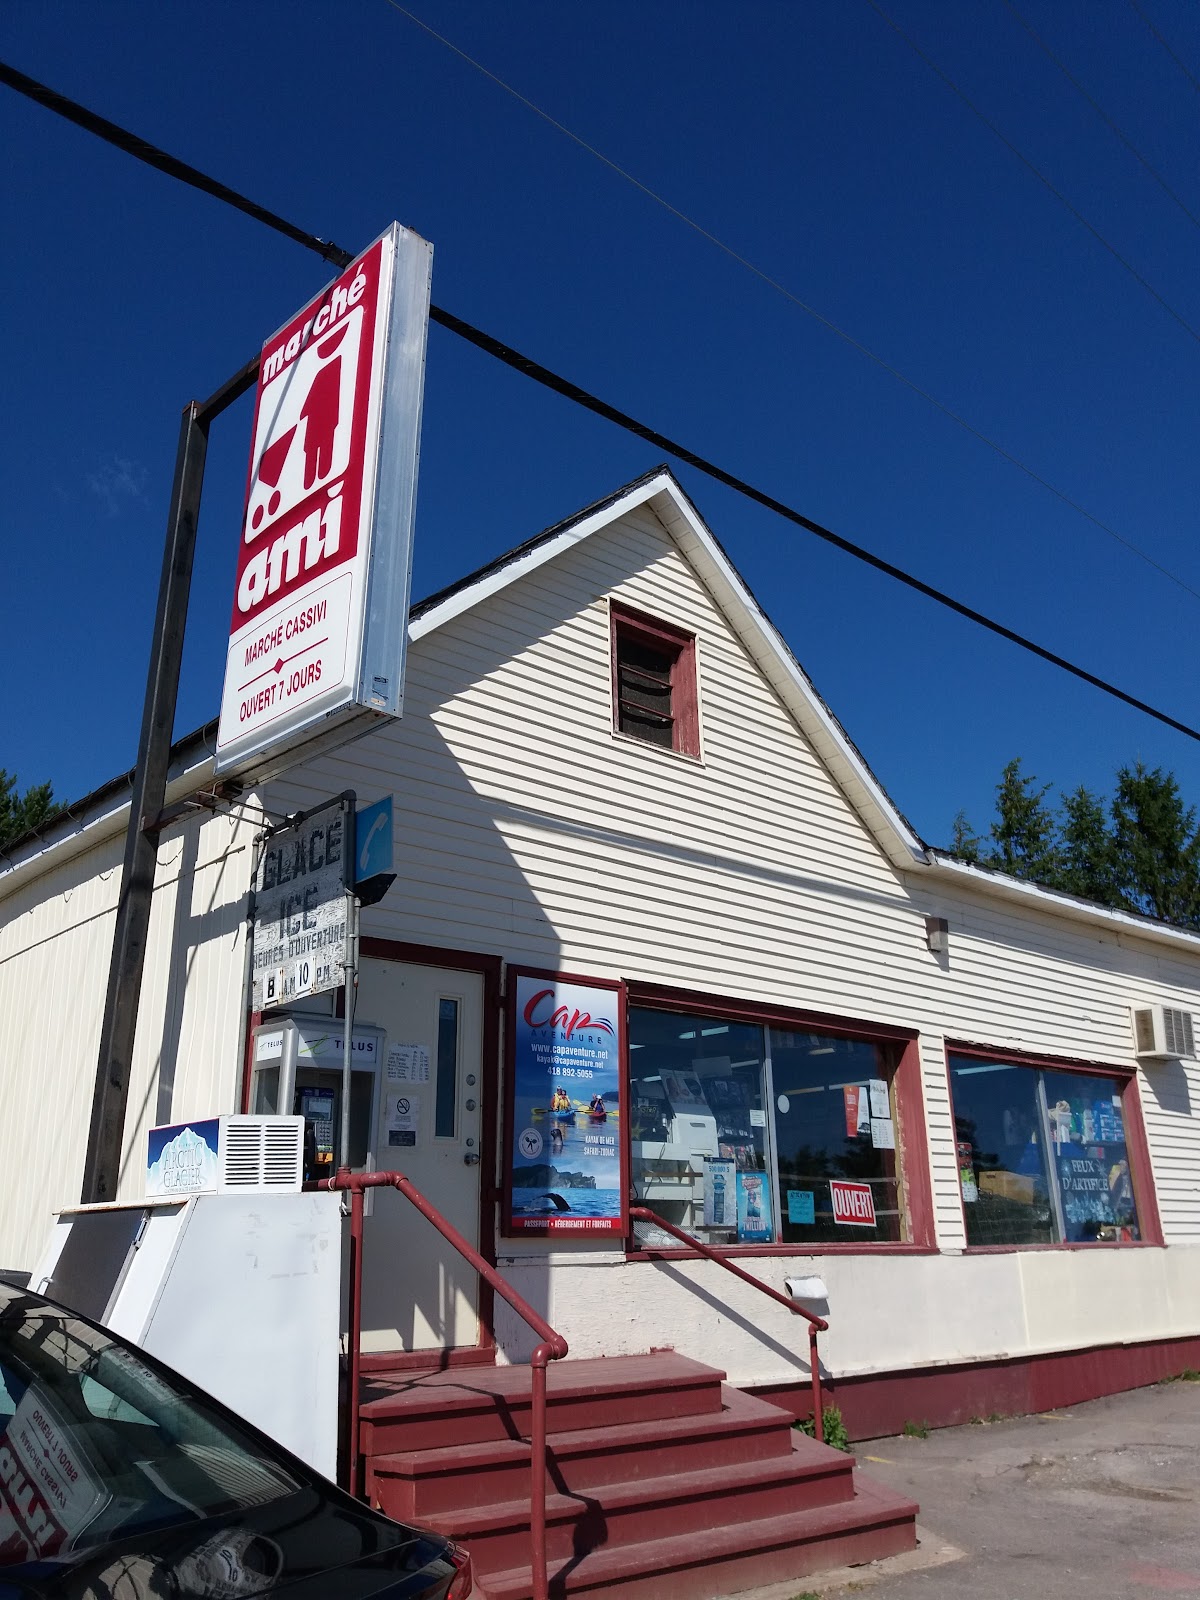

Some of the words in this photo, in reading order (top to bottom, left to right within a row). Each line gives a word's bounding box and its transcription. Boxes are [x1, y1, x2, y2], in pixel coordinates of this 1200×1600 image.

[262, 262, 366, 385] marché
[237, 480, 344, 612] ami
[244, 620, 283, 667] MARCHÉ
[285, 600, 327, 640] CASSIVI
[239, 683, 277, 722] OUVERT
[279, 681, 285, 701] 7
[286, 659, 322, 697] JOURS
[262, 820, 342, 891] GLACE
[280, 885, 317, 939] ICE
[299, 962, 309, 986] 10
[523, 989, 614, 1041] Cap
[267, 1039, 283, 1048] TELUS
[334, 1040, 373, 1052] TLUS
[530, 1029, 602, 1044] AVENTURE
[531, 1043, 608, 1059] www.capaventure.net
[536, 1054, 604, 1069] kayak@capaventure.net
[547, 1067, 560, 1076] 418
[562, 1067, 593, 1079] 892-5055
[163, 1141, 203, 1170] ARCTIC
[1071, 1160, 1094, 1173] FEUX
[163, 1167, 202, 1188] GLACIER
[833, 1188, 873, 1218] OUVERT
